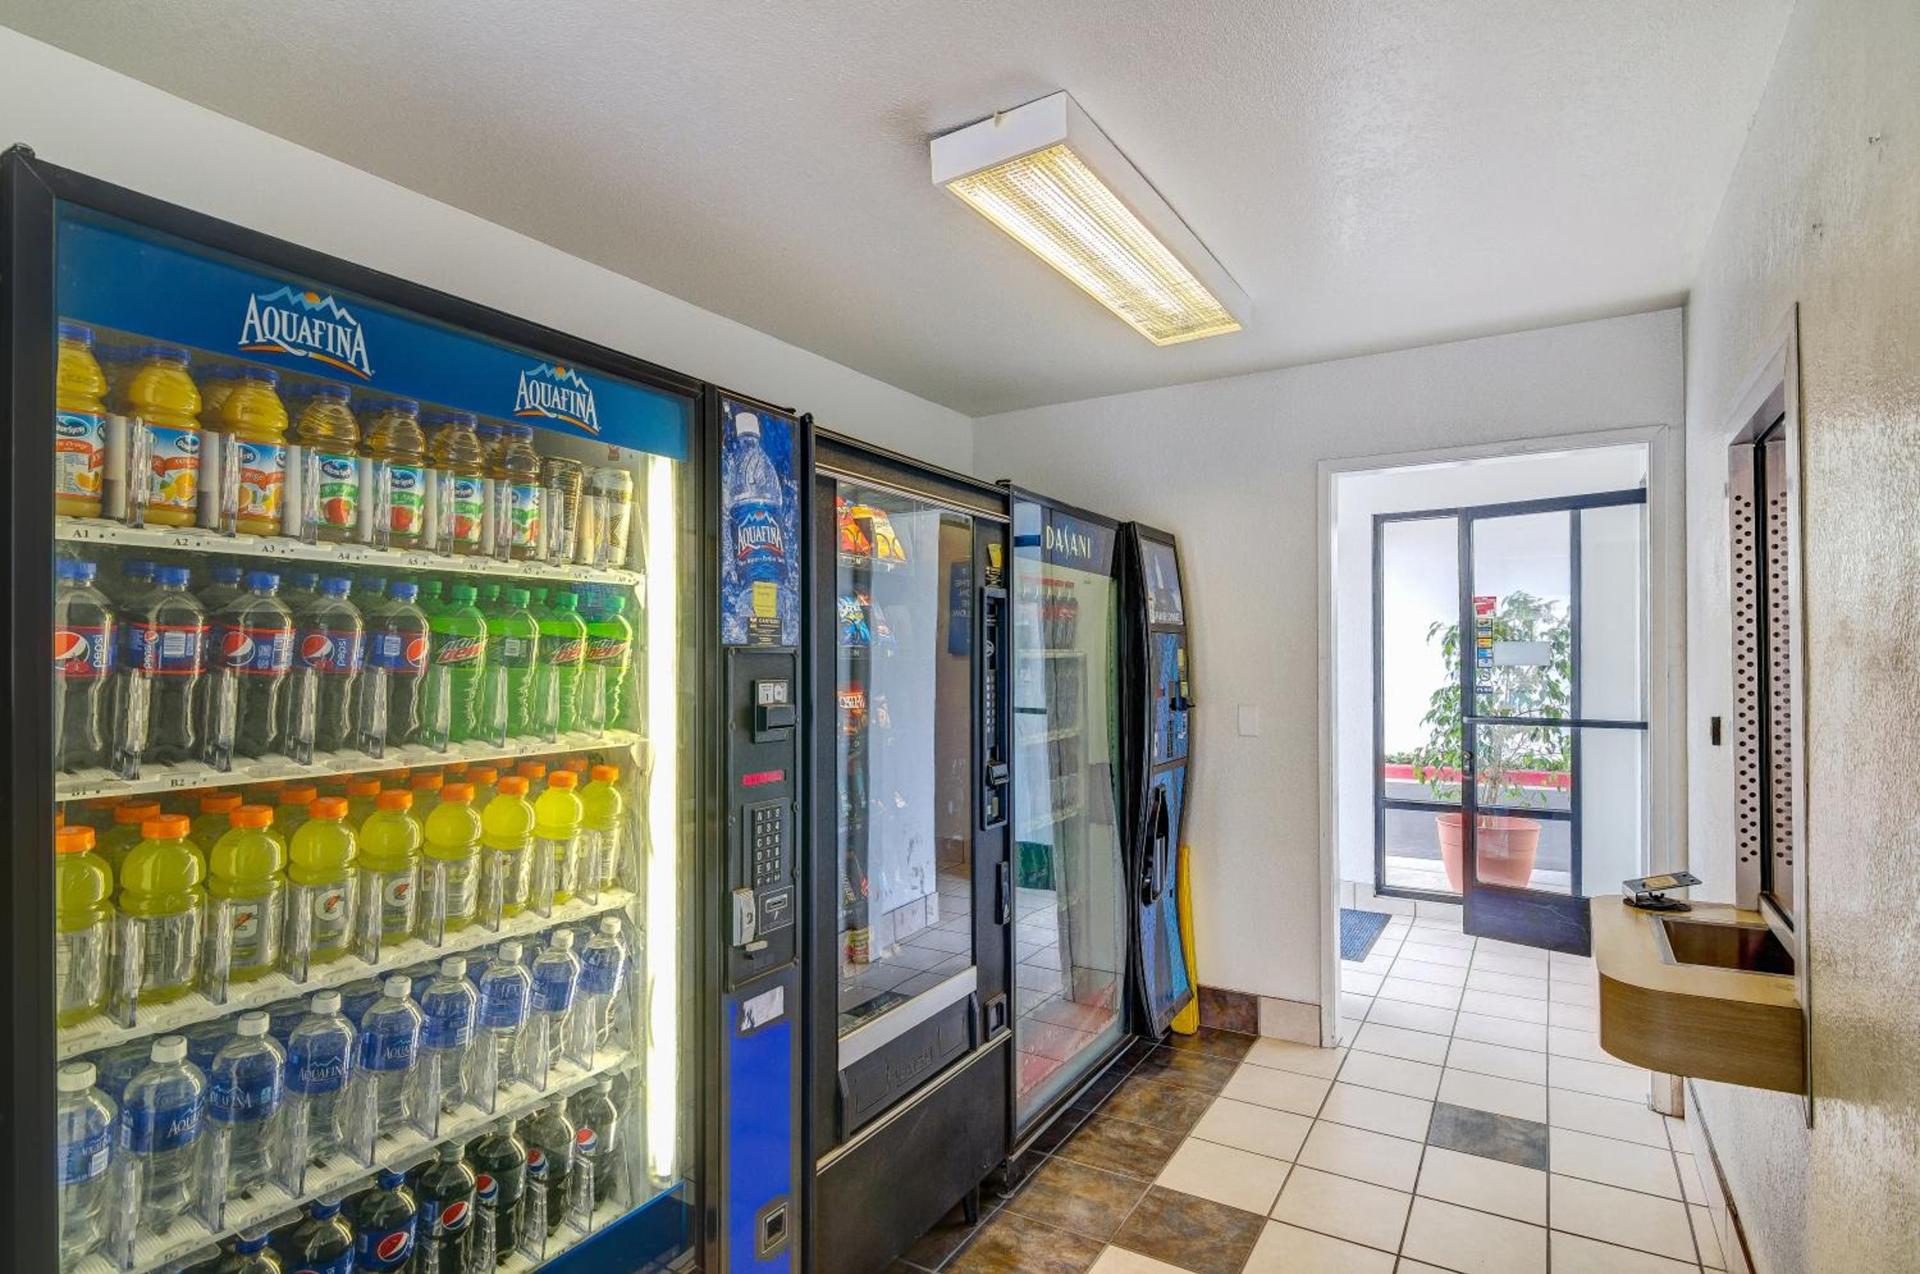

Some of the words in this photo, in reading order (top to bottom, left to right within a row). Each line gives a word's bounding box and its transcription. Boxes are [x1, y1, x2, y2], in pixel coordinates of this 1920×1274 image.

[238, 292, 374, 377] AQUAFINA
[513, 369, 600, 433] AQUAFINA
[73, 530, 89, 539] A1
[173, 538, 189, 546] A2
[737, 525, 784, 555] AQUAFINA
[1046, 525, 1091, 559] DASANI
[171, 779, 184, 787] B2
